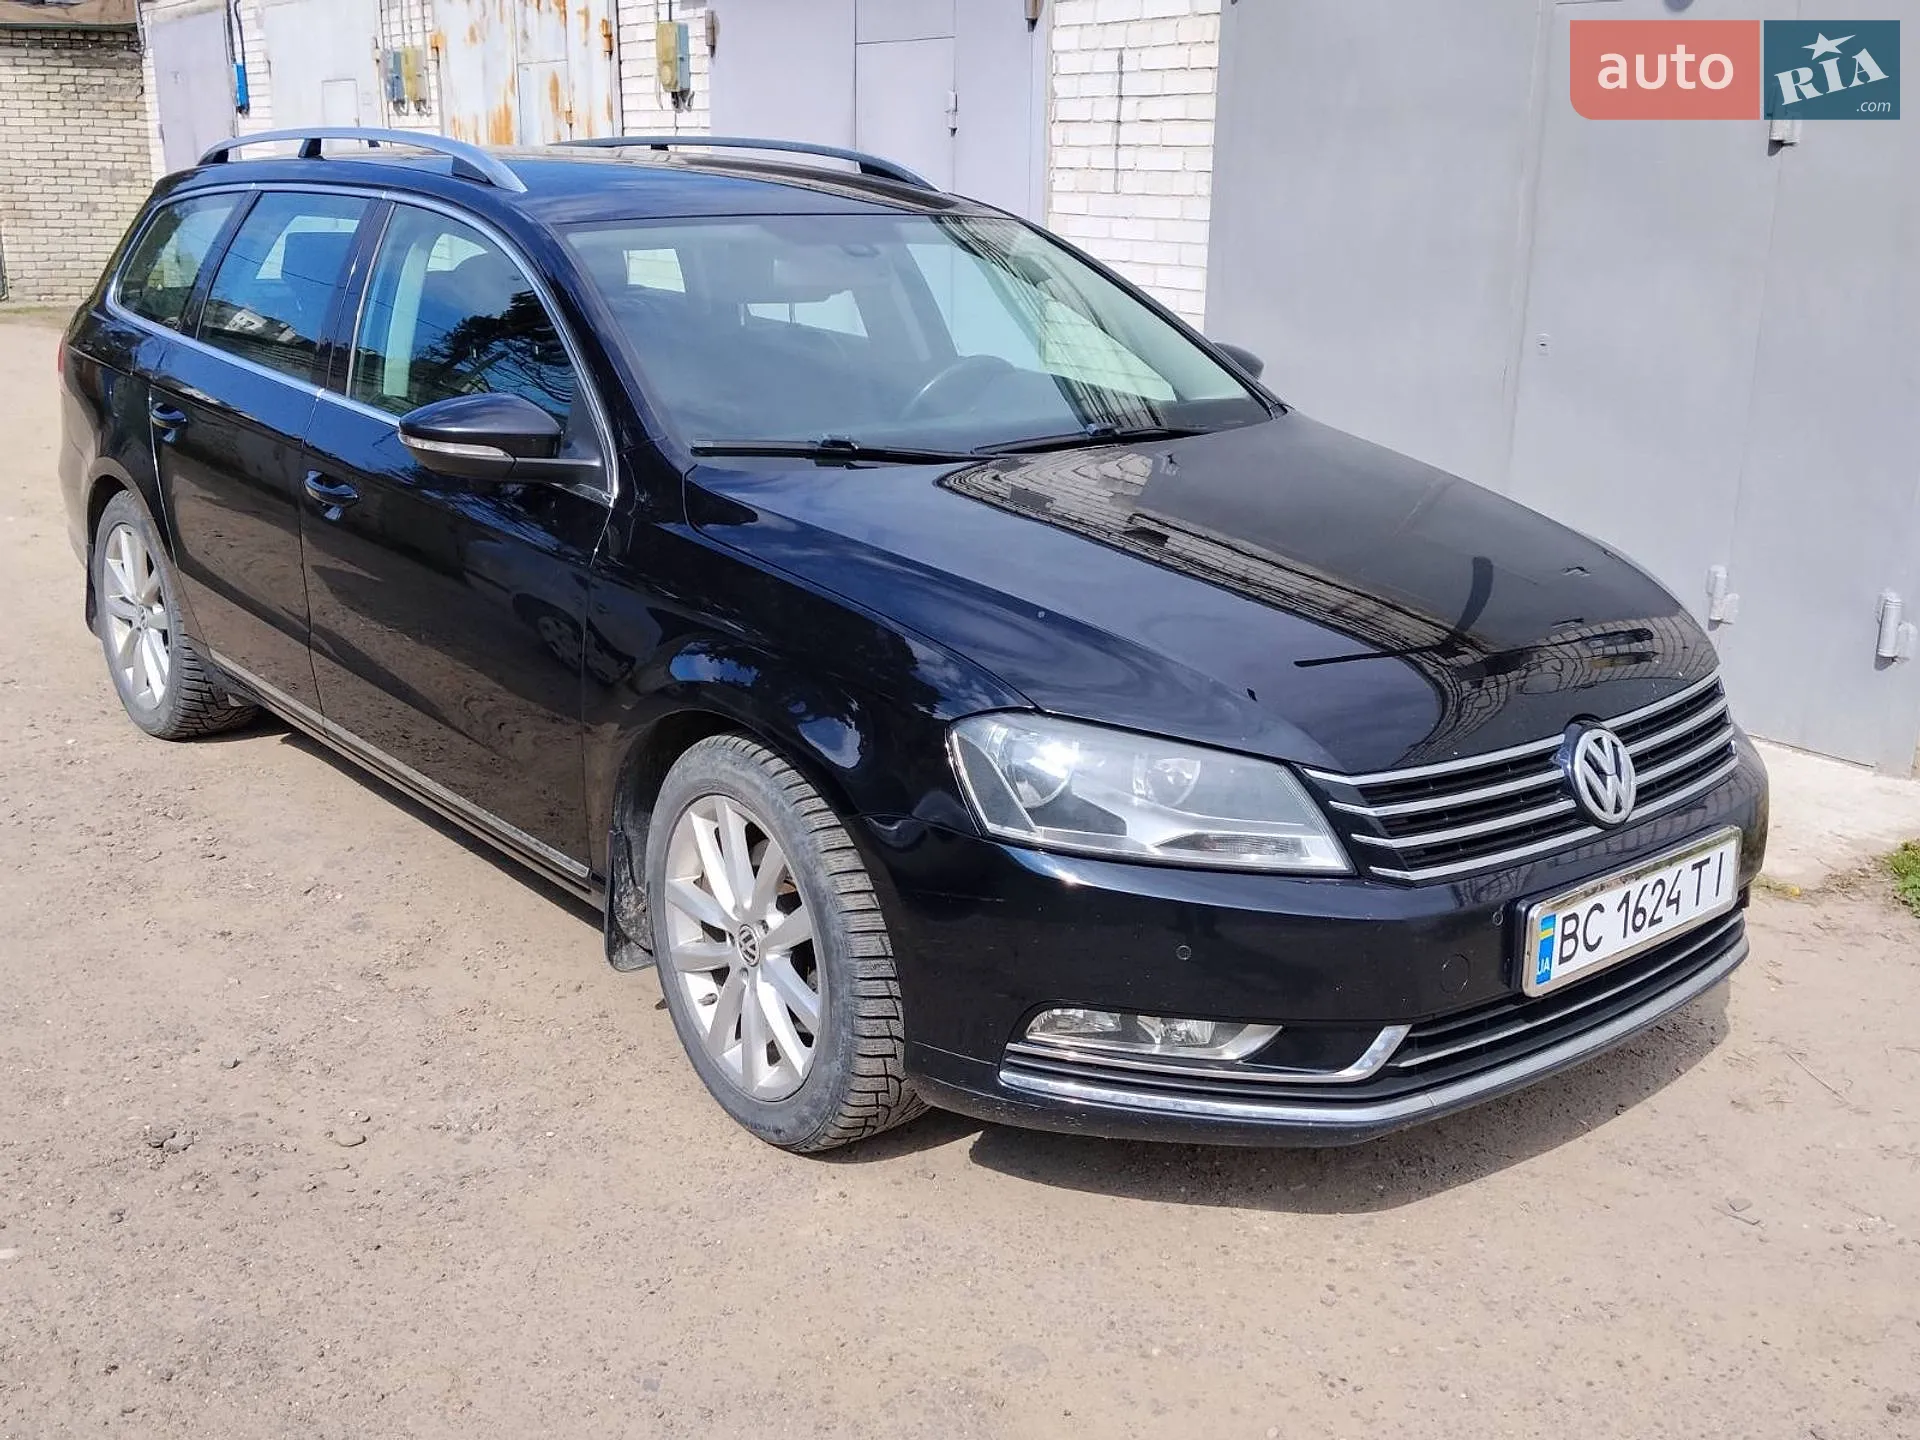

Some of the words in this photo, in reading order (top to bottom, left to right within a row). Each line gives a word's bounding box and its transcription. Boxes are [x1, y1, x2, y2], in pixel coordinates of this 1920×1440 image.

[1558, 903, 1605, 966] BC
[1616, 869, 1684, 939] 1624
[1691, 852, 1724, 906] TI
